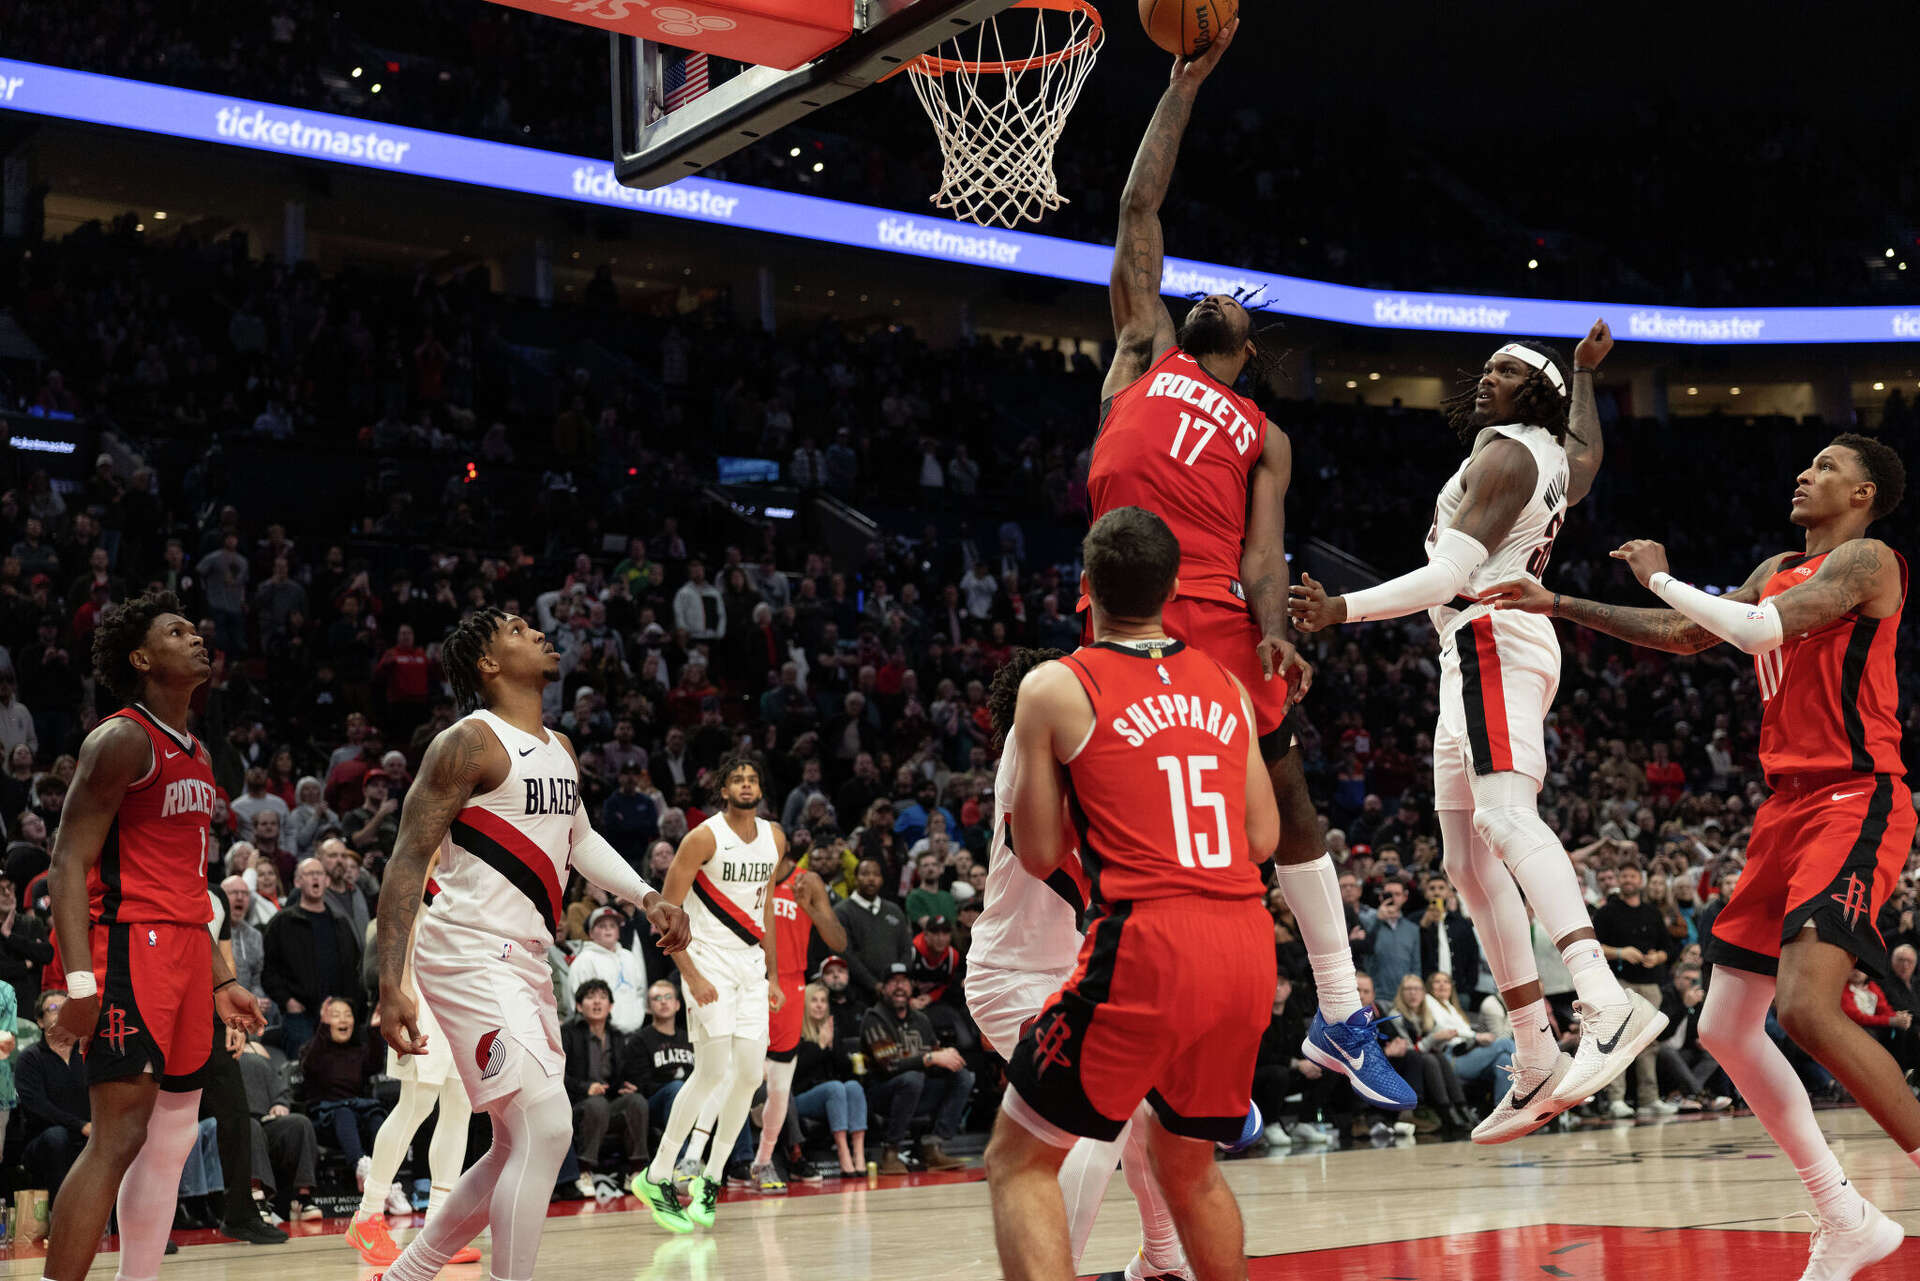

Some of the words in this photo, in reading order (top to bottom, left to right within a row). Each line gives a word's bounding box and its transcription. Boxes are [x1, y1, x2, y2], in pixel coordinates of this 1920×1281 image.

[215, 106, 410, 164] ticketmaster
[877, 218, 1021, 264] ticketmaster
[1372, 297, 1511, 329] ticketmaster
[1628, 311, 1764, 339] ticketmaster
[1146, 373, 1257, 456] ROCKETS
[1169, 411, 1218, 466] 17
[1113, 694, 1238, 747] SHEPPARD
[1157, 755, 1231, 868] 15
[722, 861, 774, 882] BLAZERS
